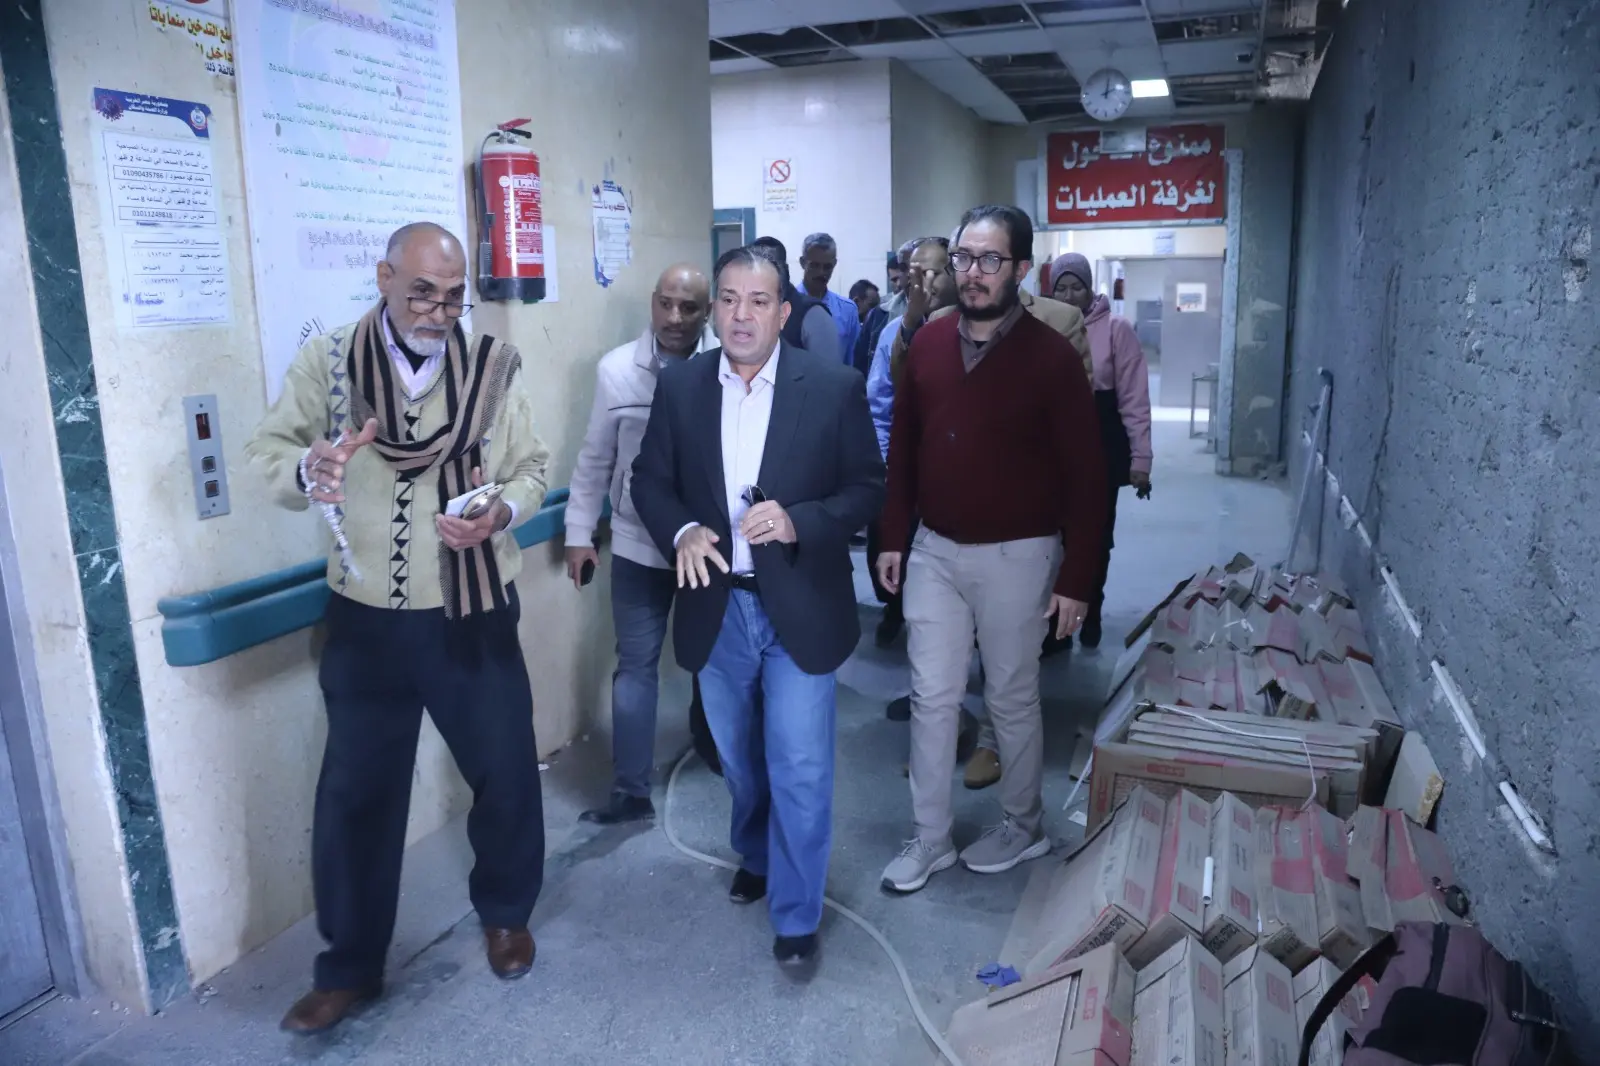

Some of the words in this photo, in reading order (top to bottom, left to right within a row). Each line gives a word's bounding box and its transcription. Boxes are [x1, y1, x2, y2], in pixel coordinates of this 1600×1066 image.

[1148, 134, 1212, 166] ممنوع
[1056, 184, 1145, 216] العمليات
[1150, 180, 1216, 212] لغرفة
